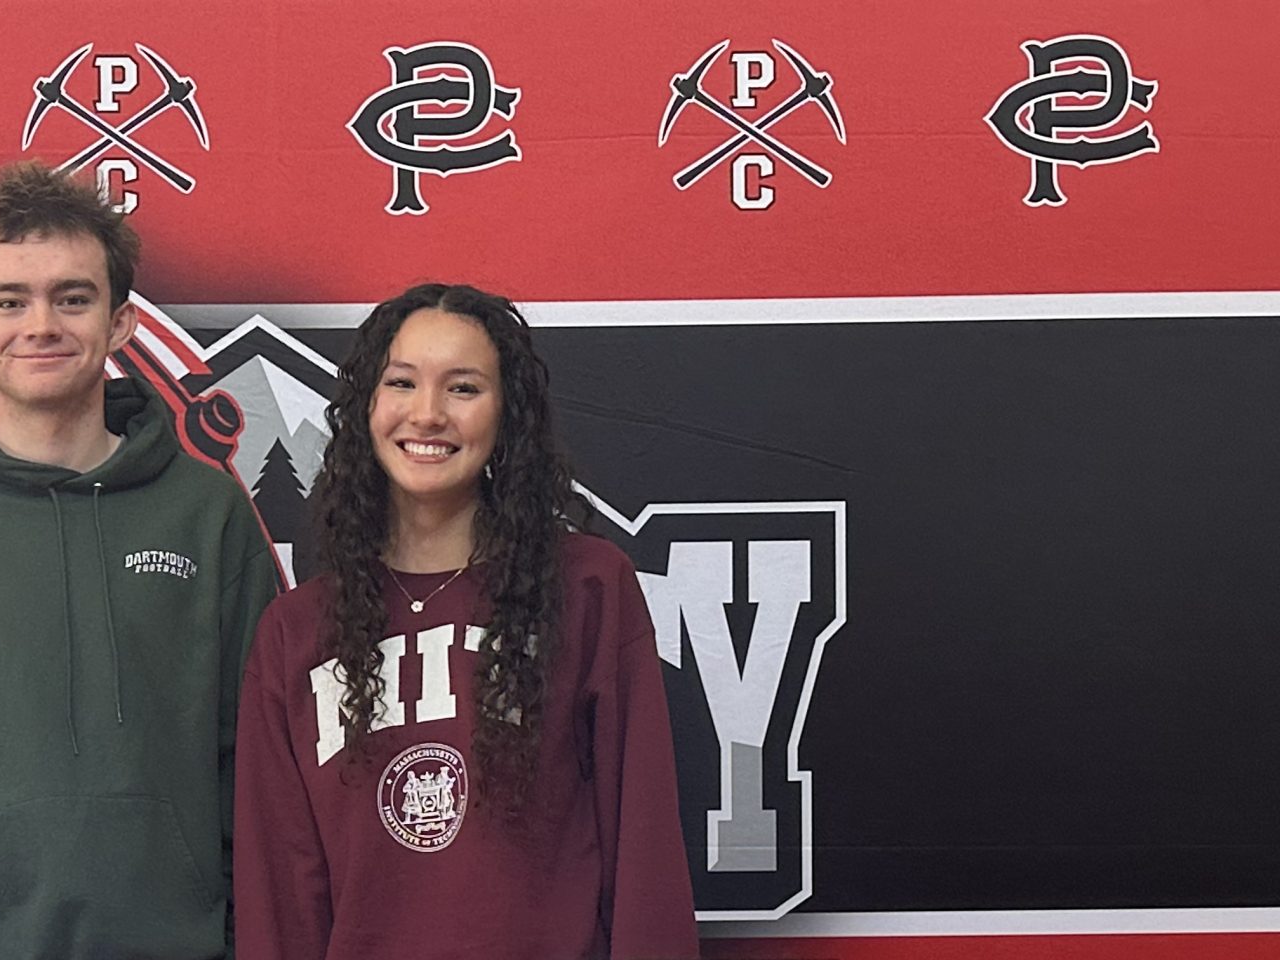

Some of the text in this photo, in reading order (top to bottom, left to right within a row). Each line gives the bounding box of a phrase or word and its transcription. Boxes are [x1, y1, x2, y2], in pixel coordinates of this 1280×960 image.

[92, 54, 140, 113] P
[729, 51, 776, 109] P
[95, 157, 139, 214] C
[730, 153, 777, 211] C
[124, 550, 198, 577] DARTMOUTH
